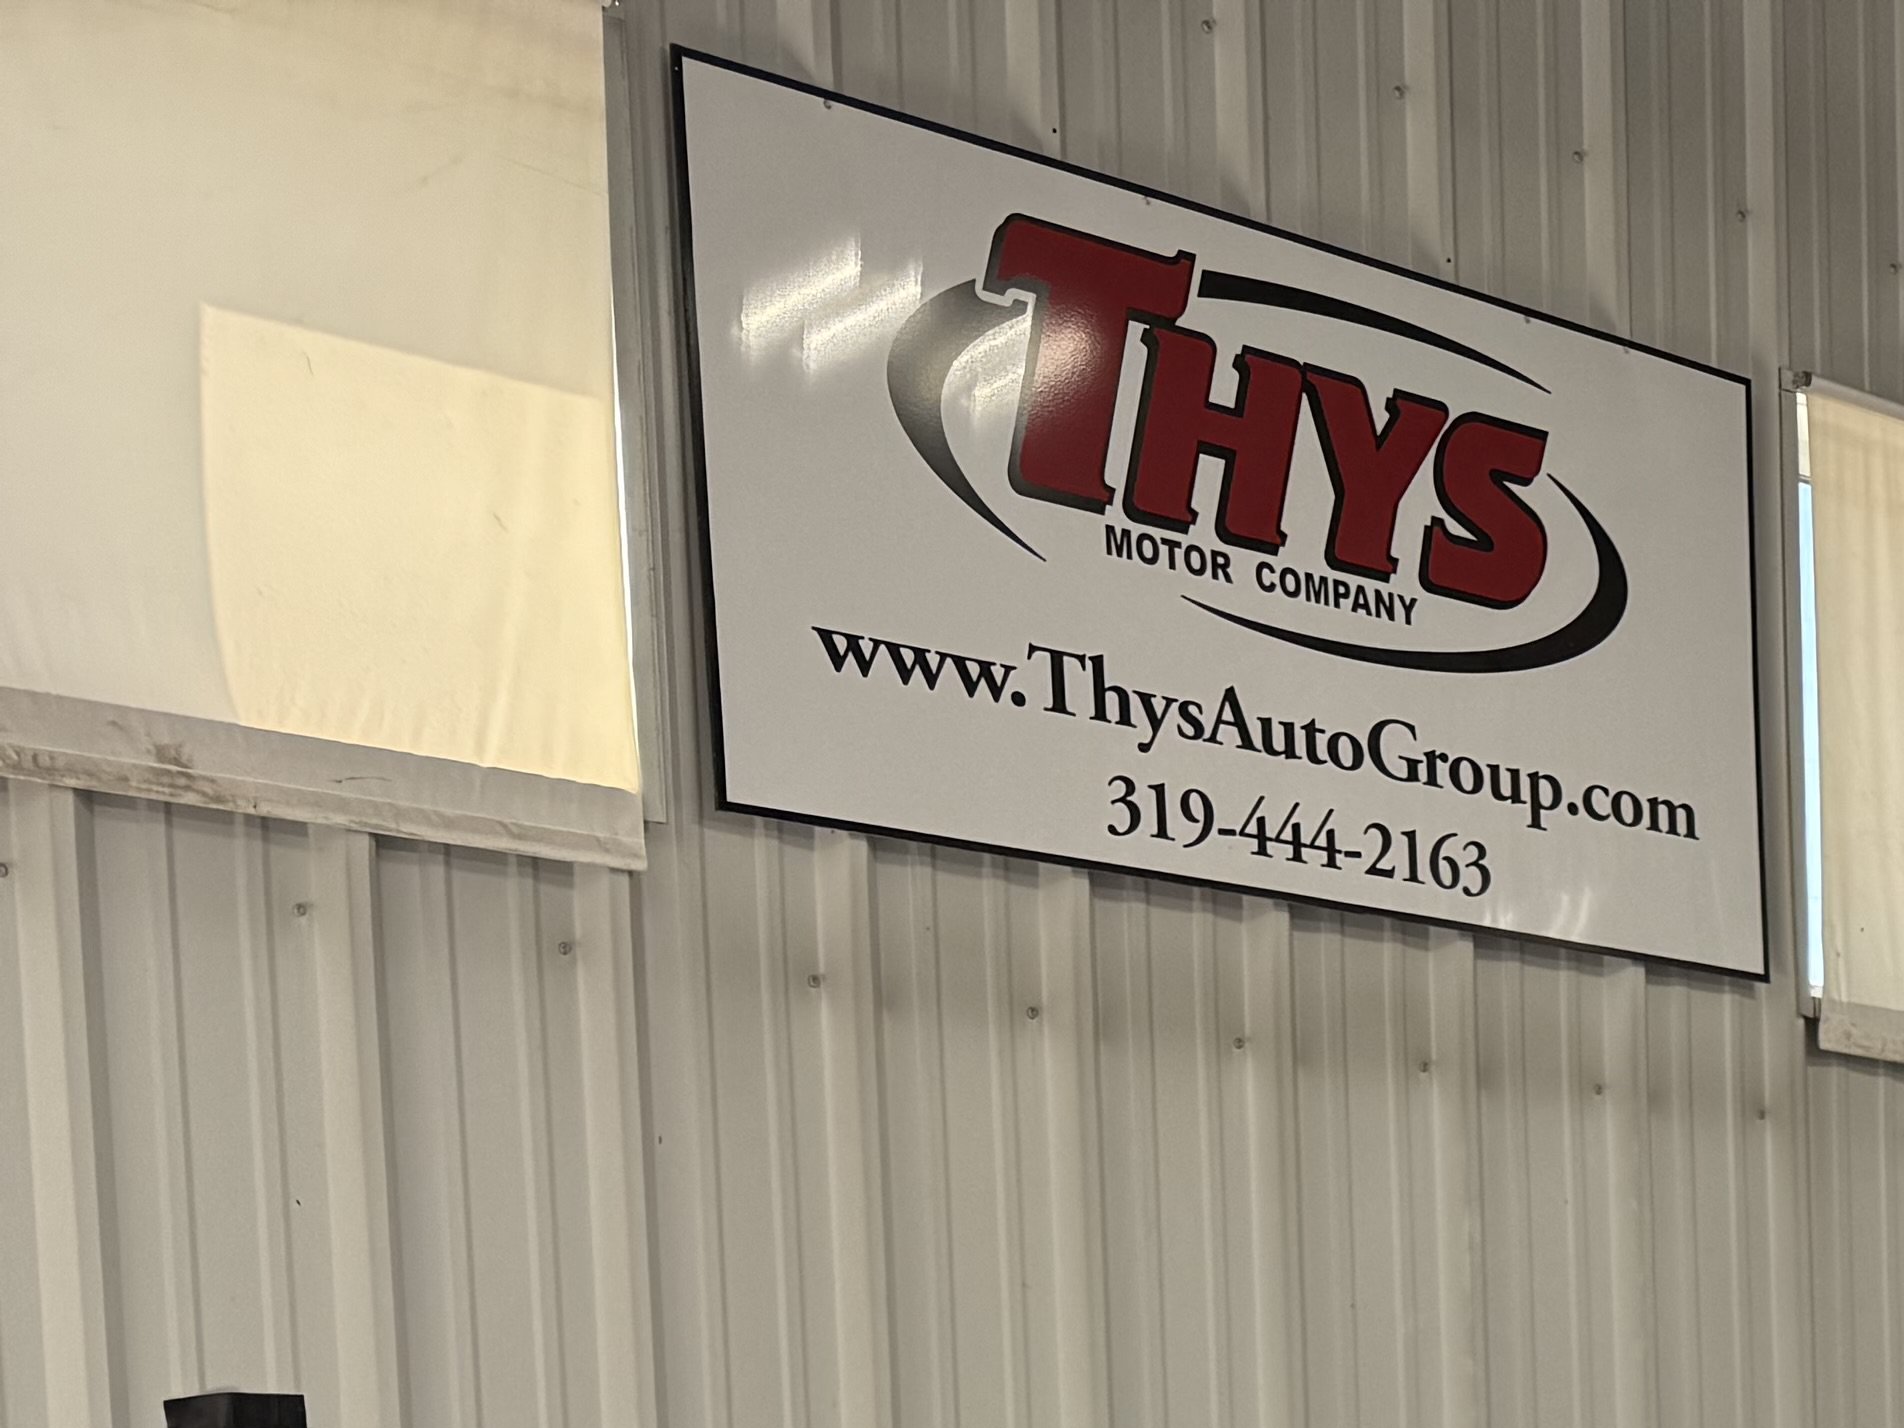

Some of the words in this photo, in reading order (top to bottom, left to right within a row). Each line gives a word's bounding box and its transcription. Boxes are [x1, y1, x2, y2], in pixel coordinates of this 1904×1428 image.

[983, 213, 1549, 610] THYS
[1105, 524, 1234, 584] MOTOR
[1255, 561, 1418, 626] COMPANY
[812, 626, 1699, 841] www.ThysAutoGroup.com
[1107, 776, 1493, 897] 319-444-2163
